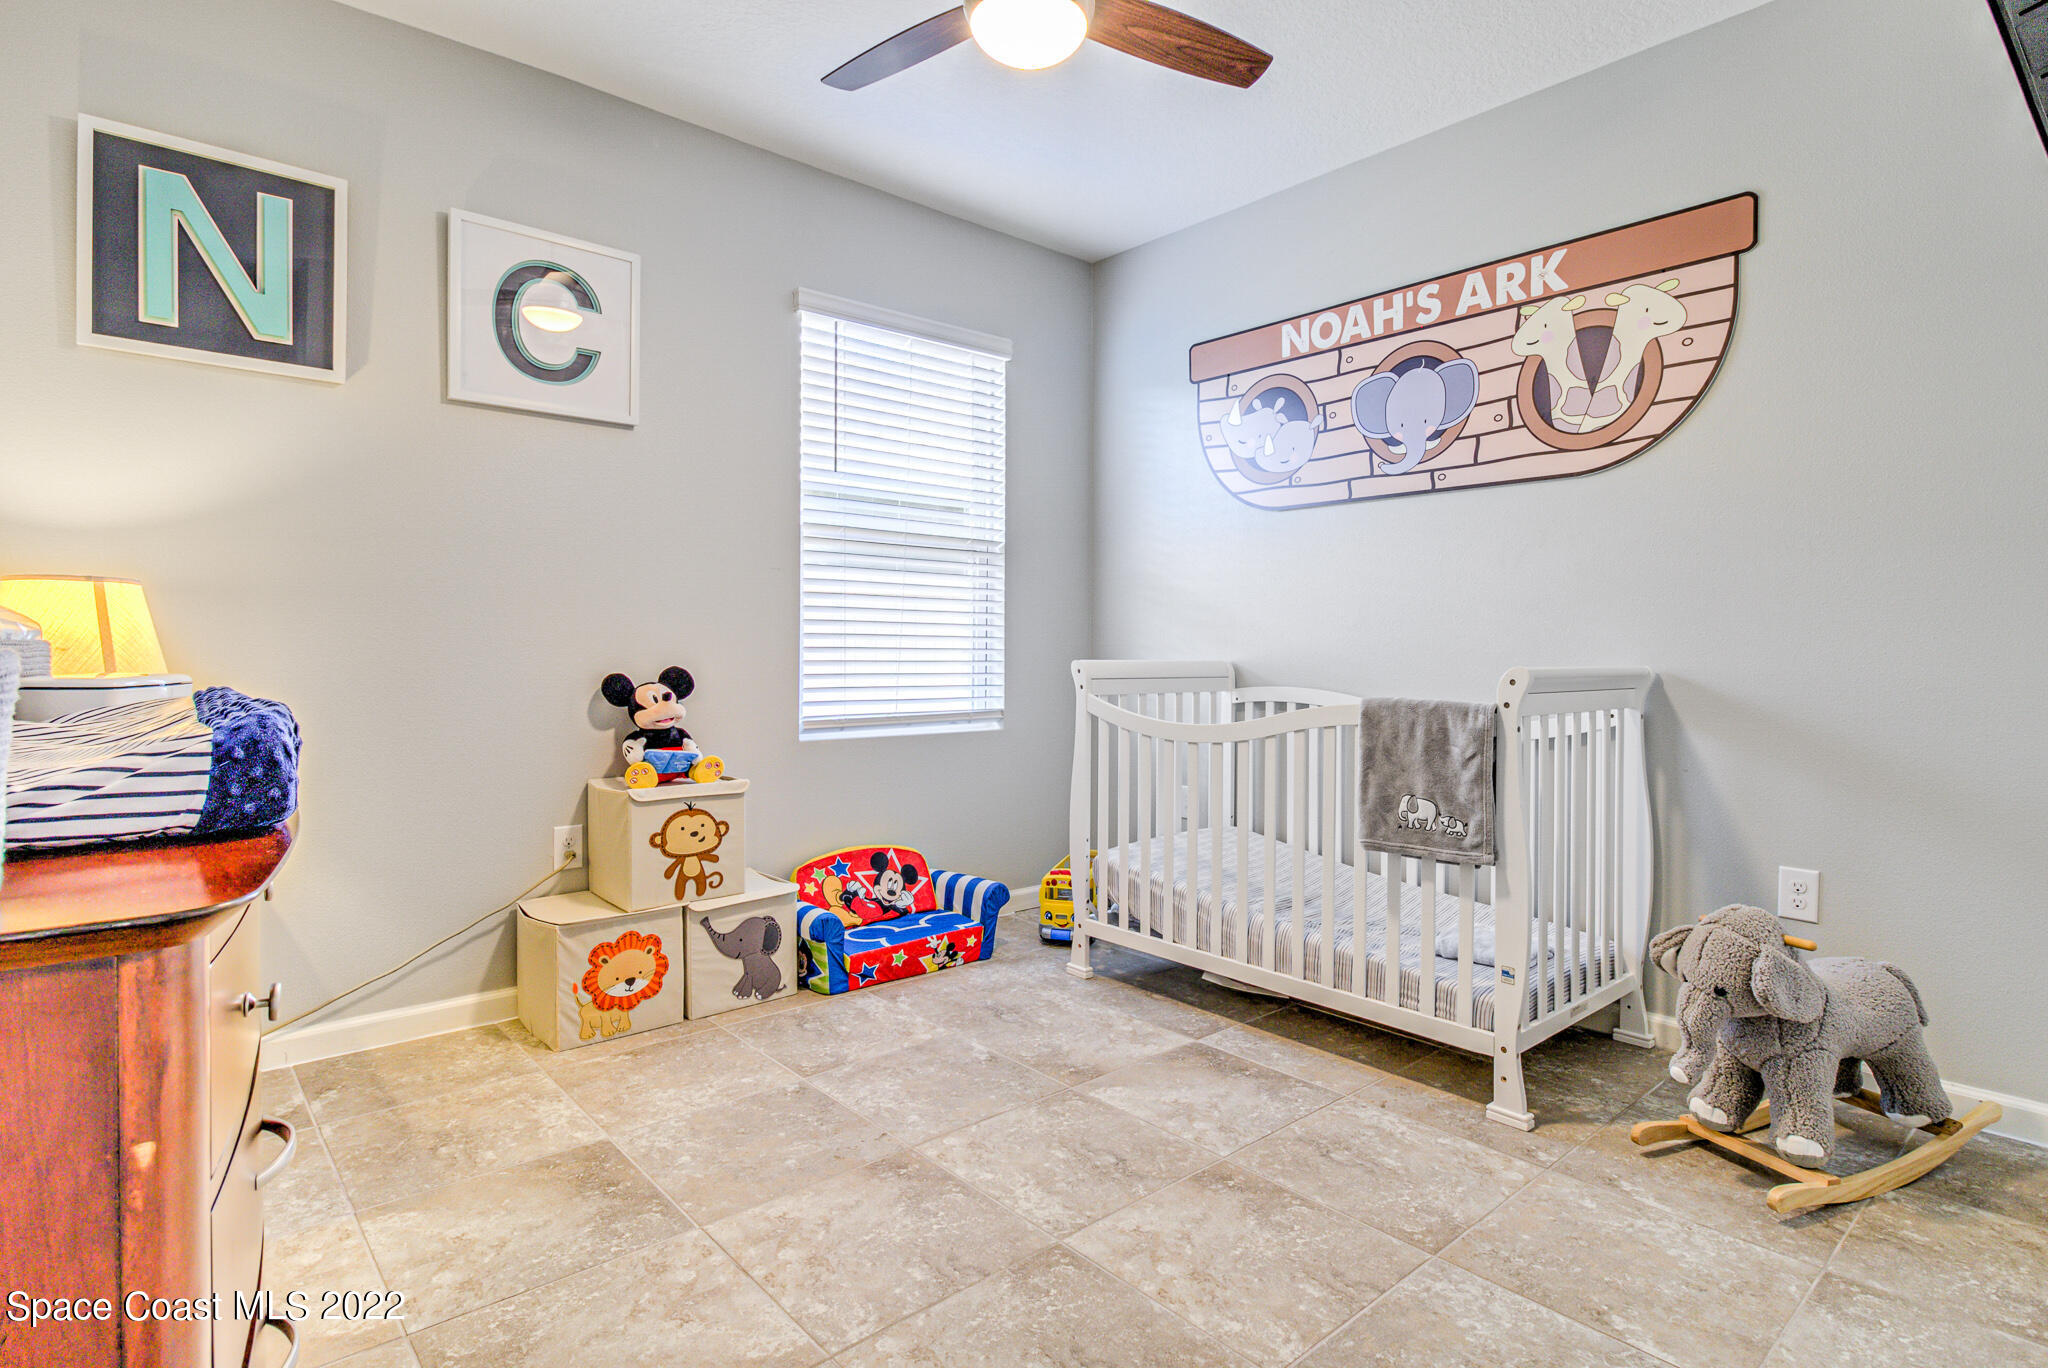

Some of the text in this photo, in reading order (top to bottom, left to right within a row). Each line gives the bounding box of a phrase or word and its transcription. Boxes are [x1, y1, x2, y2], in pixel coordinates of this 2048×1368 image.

[138, 164, 294, 346] N
[1281, 250, 1568, 359] NOAH'S ARK
[493, 259, 602, 386] C
